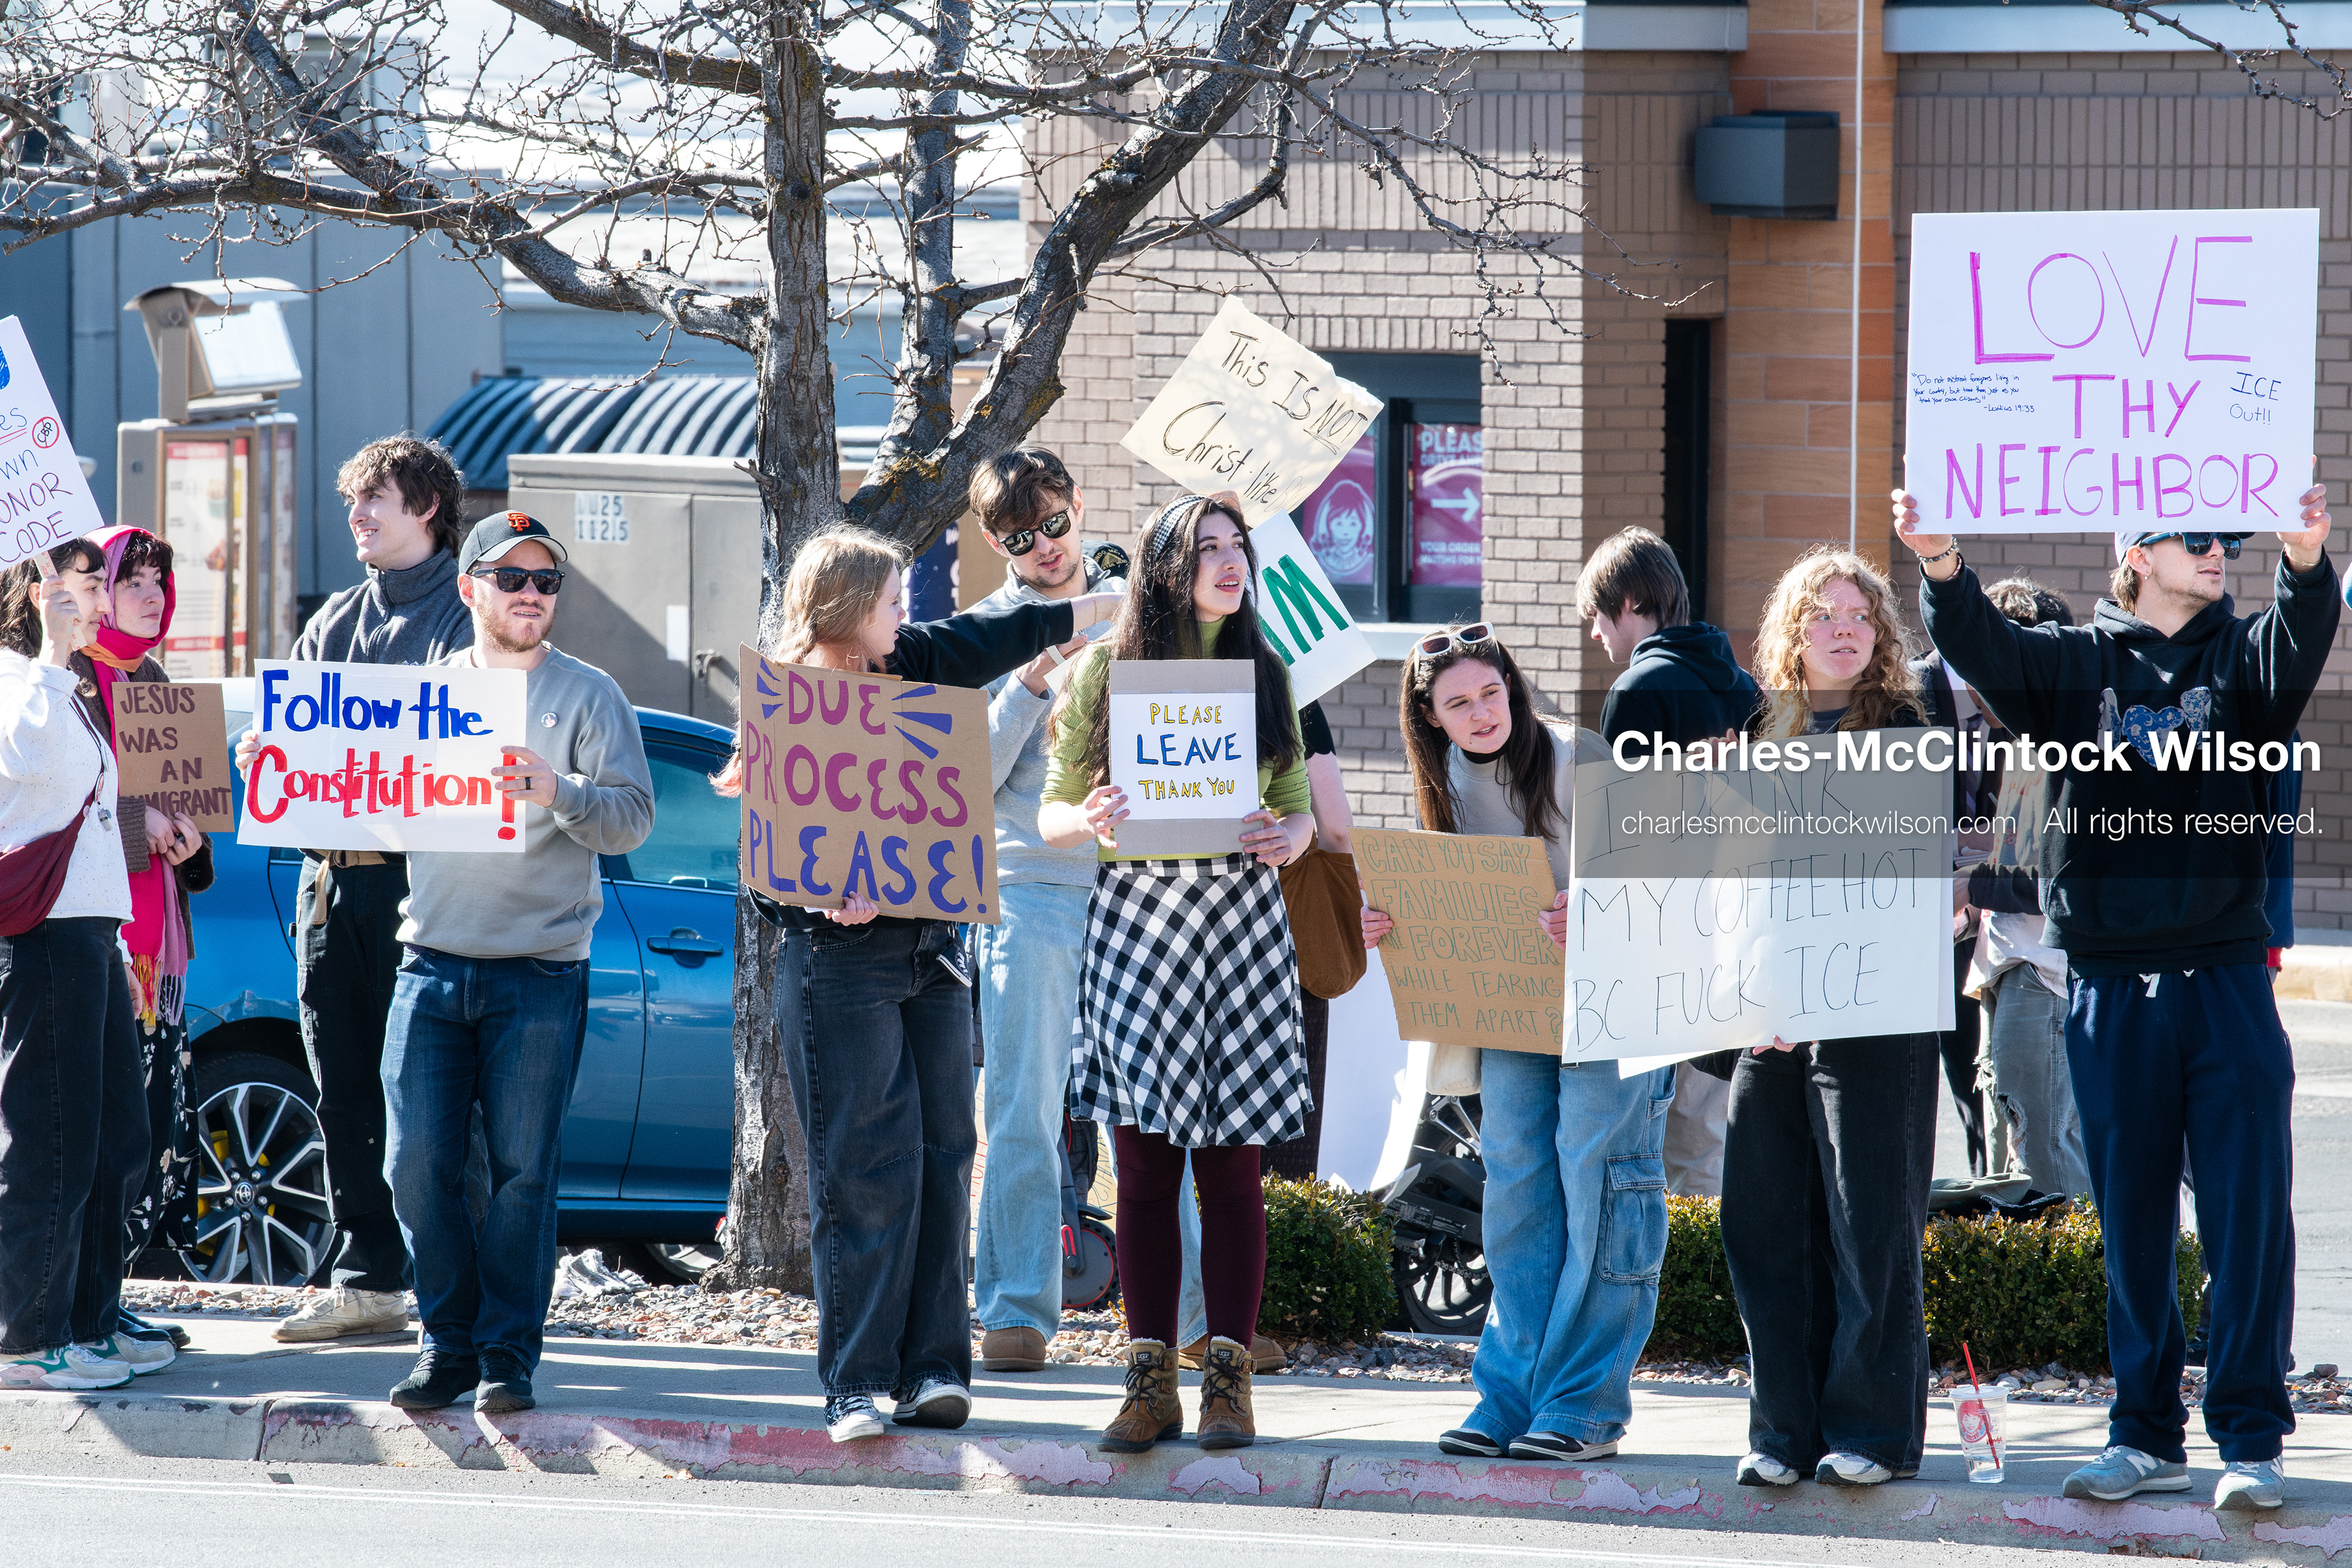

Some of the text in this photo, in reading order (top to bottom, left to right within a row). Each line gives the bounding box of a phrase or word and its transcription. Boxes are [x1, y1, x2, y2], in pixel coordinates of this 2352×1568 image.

[1970, 235, 2253, 364] LOVE
[1221, 331, 1368, 444] This IS NOT
[1934, 375, 1945, 384] not
[1996, 373, 2009, 385] living
[1950, 386, 1960, 394] but
[1988, 386, 1999, 395] just
[2230, 371, 2282, 401] ICE
[2015, 404, 2035, 413] 19:33
[2052, 374, 2201, 439] THY
[37, 421, 53, 443] CBP
[1420, 431, 1483, 454] PLEAS
[1945, 443, 2280, 519] NEIGHBOR
[119, 684, 195, 715] JESUS
[262, 669, 494, 741] Follow the
[788, 670, 886, 735] DUE
[1150, 703, 1222, 725] PLEASE
[119, 726, 178, 753] WAS
[1137, 733, 1242, 766] LEAVE
[160, 757, 202, 785] AN
[745, 720, 968, 827] PROCESS
[1138, 777, 1235, 801] THANK YOU
[130, 786, 232, 818] MIGRANT
[246, 744, 517, 841] Constitution!
[1580, 758, 1858, 865] I DRINK
[750, 807, 987, 914] PLEASE!
[1362, 834, 1531, 876] CAN YOU SAY
[1371, 878, 1544, 925] FAMILIES
[1582, 848, 1928, 952] MY COFFEE HOT
[1408, 925, 1559, 966] FOREVER
[1390, 965, 1562, 998] WHILE TEARING
[1572, 941, 1880, 1052] BC FUCK ICE
[1408, 1001, 1461, 1028] THEM
